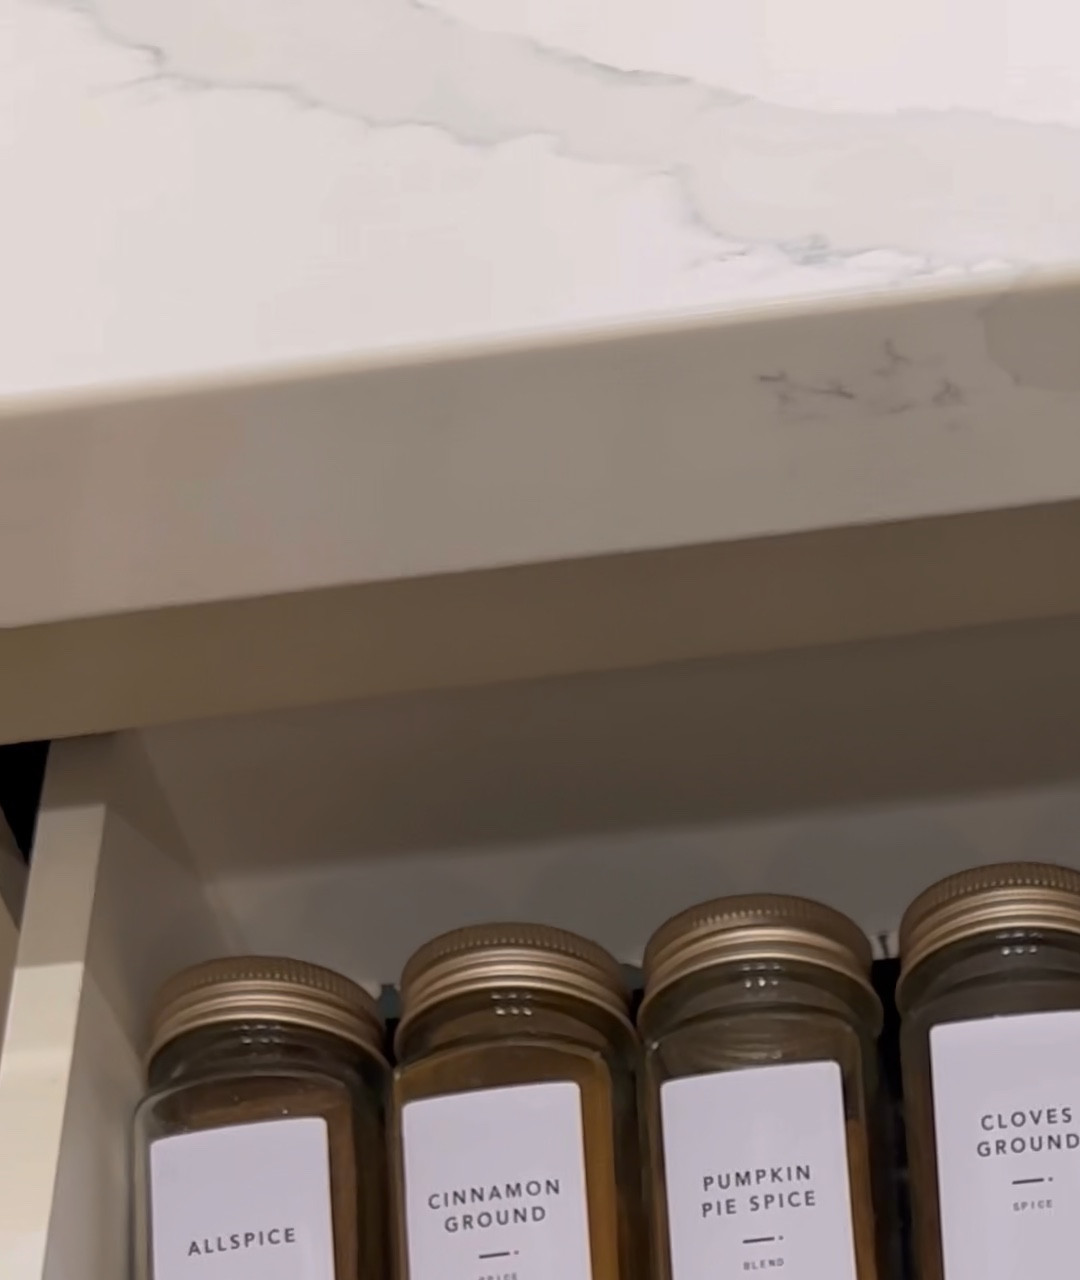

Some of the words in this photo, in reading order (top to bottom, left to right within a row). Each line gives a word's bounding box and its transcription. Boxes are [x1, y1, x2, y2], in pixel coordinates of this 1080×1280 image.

[980, 1106, 1073, 1132] CLOVES
[976, 1132, 1080, 1158] GROUND
[702, 1164, 811, 1192] PUMPKIN
[427, 1178, 560, 1210] CINNAMON
[701, 1197, 737, 1219] PIE
[748, 1189, 816, 1212] SPICE
[1012, 1198, 1053, 1212] SPICE
[444, 1205, 546, 1234] GROUND
[187, 1227, 296, 1257] ALLSPICE
[742, 1257, 785, 1271] BLEND
